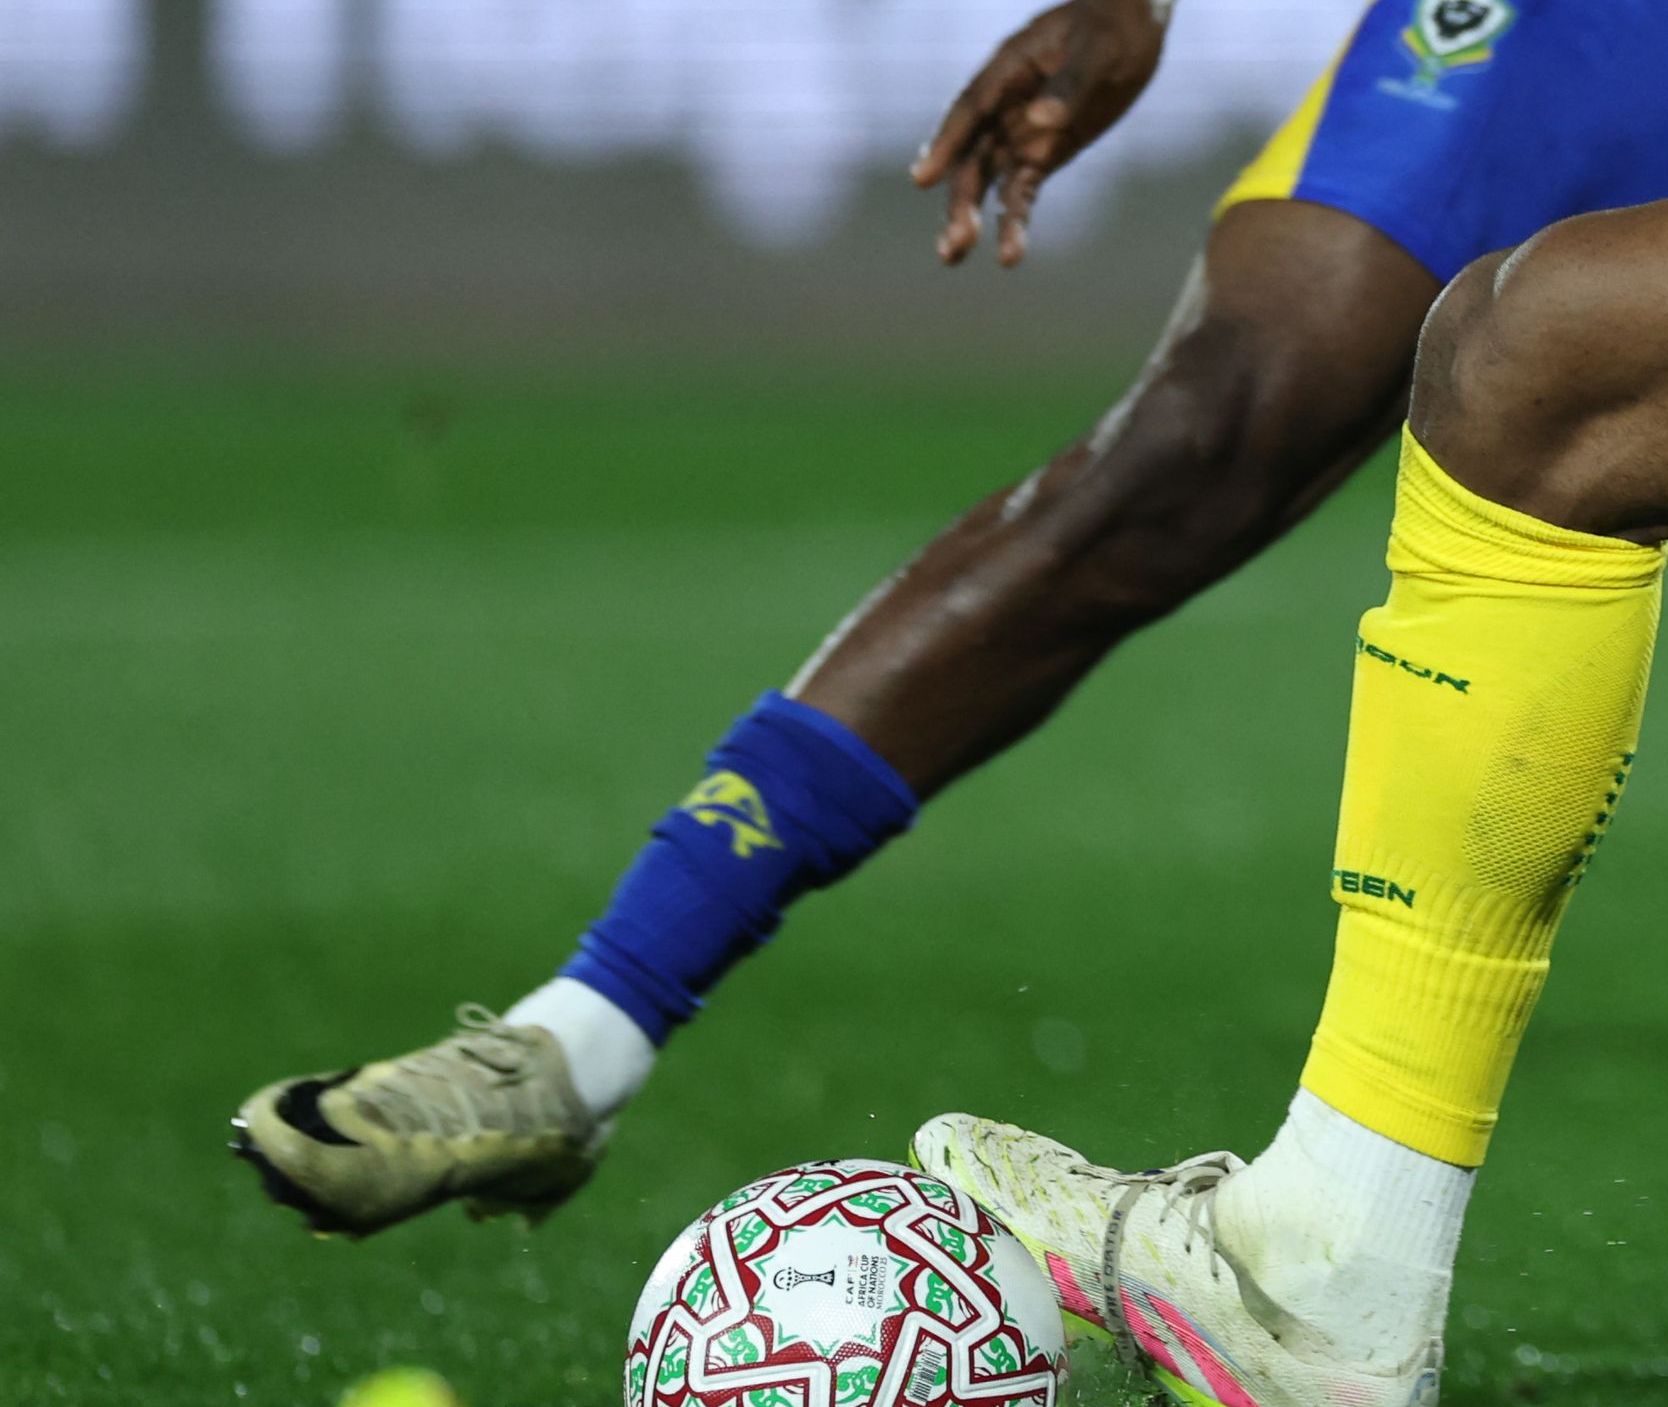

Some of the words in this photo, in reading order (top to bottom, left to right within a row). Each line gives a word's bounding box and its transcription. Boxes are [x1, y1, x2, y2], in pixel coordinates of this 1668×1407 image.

[860, 1254, 869, 1272] CUP
[868, 1255, 879, 1294] NATIONS
[845, 1276, 854, 1305] CAF
[857, 1274, 867, 1307] AFRICA
[866, 1295, 876, 1308] OF
[876, 1266, 887, 1310] MOROCCO
